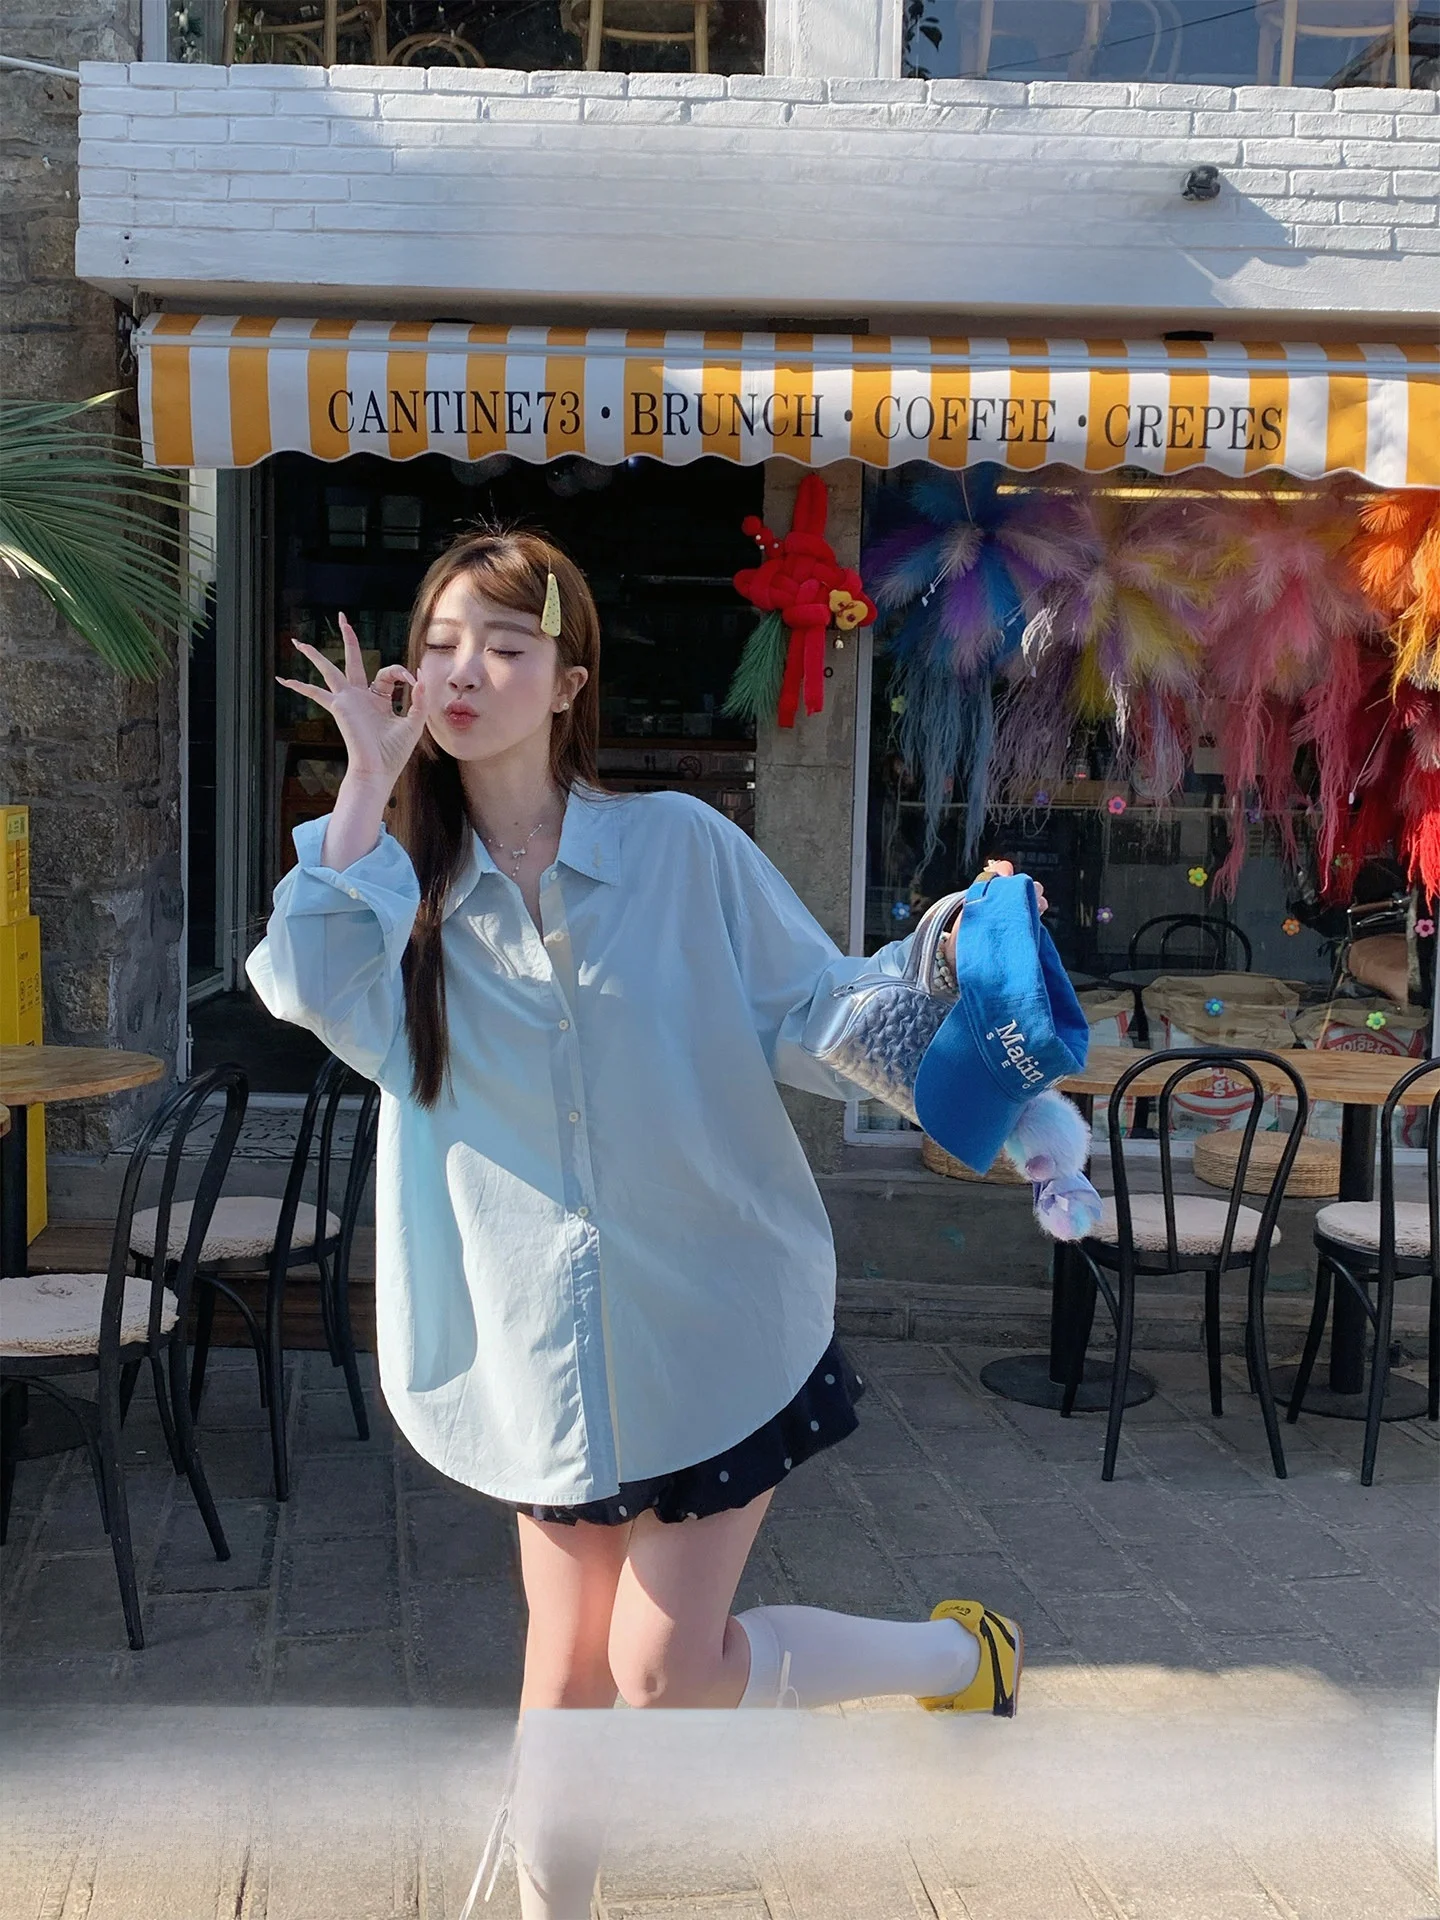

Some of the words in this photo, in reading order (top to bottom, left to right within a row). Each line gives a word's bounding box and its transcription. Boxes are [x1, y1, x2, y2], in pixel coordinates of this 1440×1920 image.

[328, 389, 581, 435] CANTINE73
[630, 392, 824, 438] BRUNCH
[874, 396, 1057, 443] COFFEE
[1104, 404, 1283, 450] CREPES
[994, 1019, 1045, 1083] Matin
